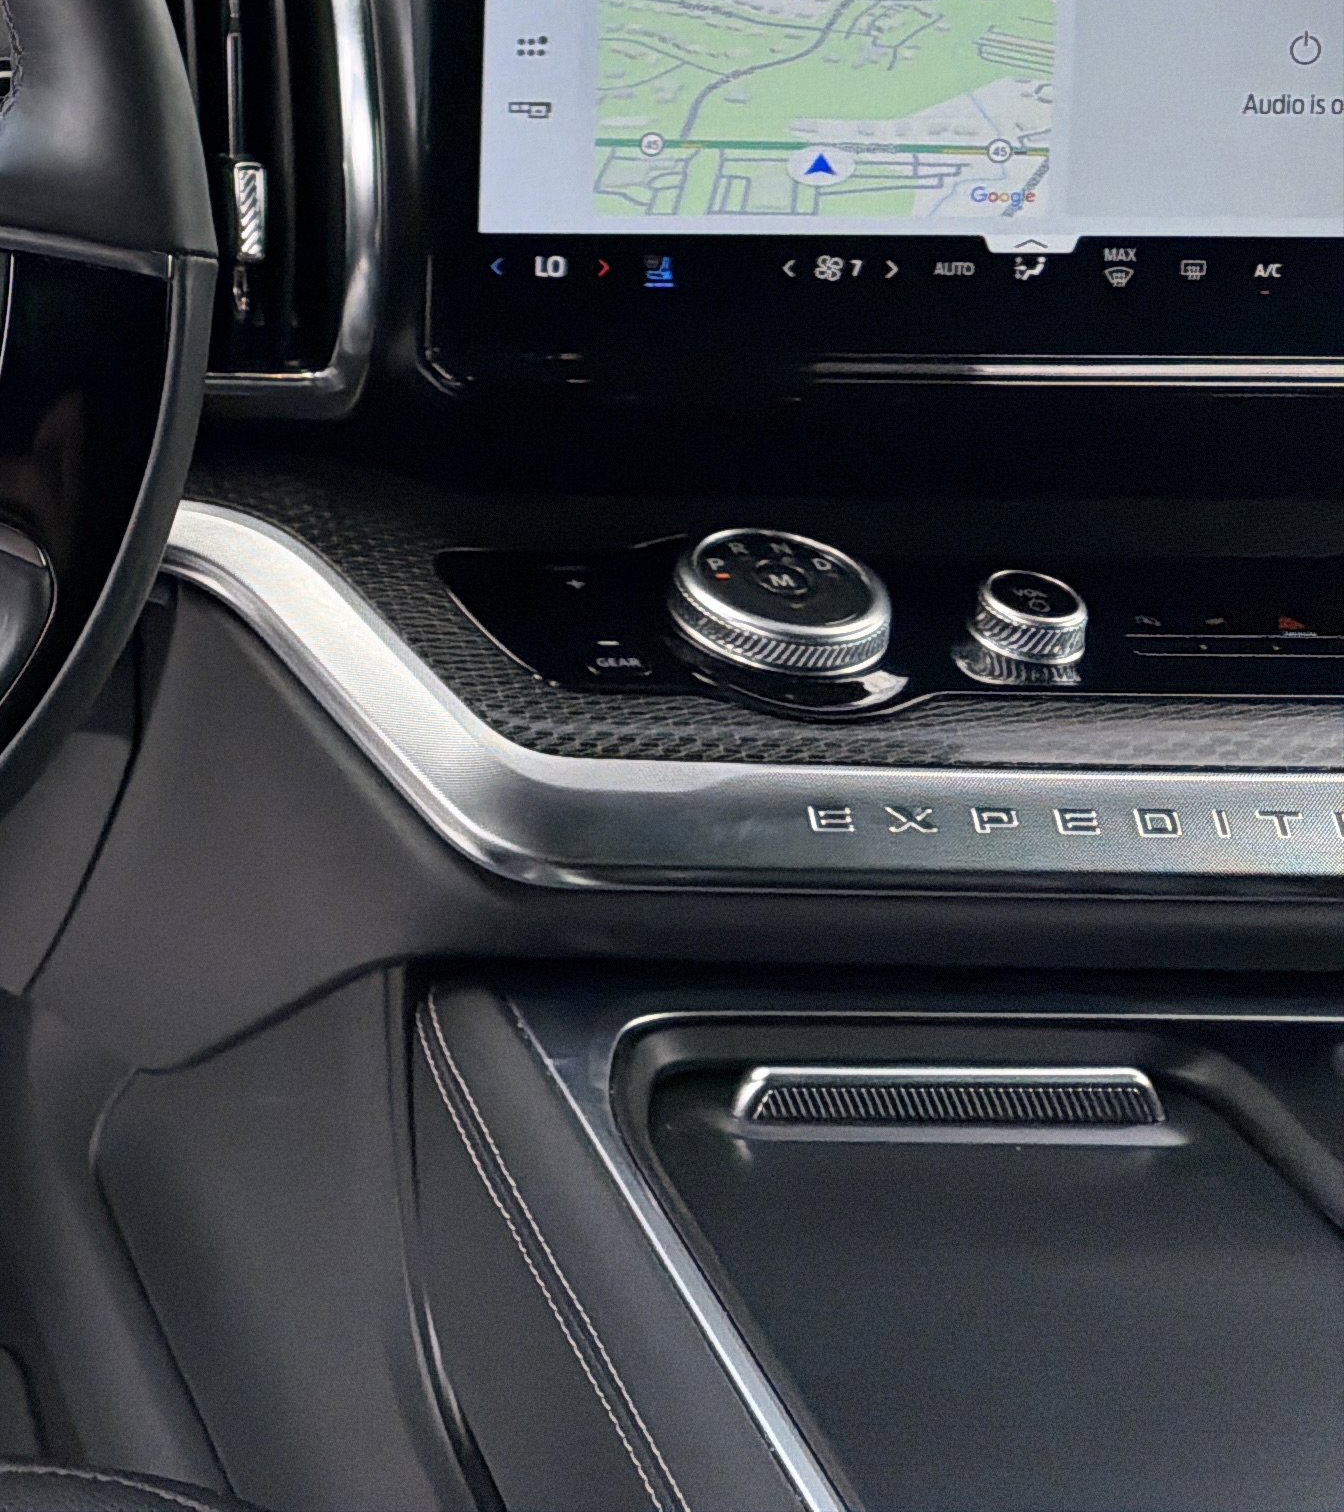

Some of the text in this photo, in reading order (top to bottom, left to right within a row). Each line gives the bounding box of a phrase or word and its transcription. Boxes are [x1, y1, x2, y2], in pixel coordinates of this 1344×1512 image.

[1242, 93, 1305, 115] Audio
[1310, 93, 1326, 115] is
[971, 186, 1036, 204] Google
[1103, 247, 1137, 262] MAX
[534, 255, 567, 278] LO
[850, 259, 863, 277] 7
[933, 261, 975, 277] AUTO
[1254, 263, 1283, 279] A/C
[706, 541, 832, 571] P R N D
[768, 573, 795, 587] M
[596, 657, 641, 667] GEAR
